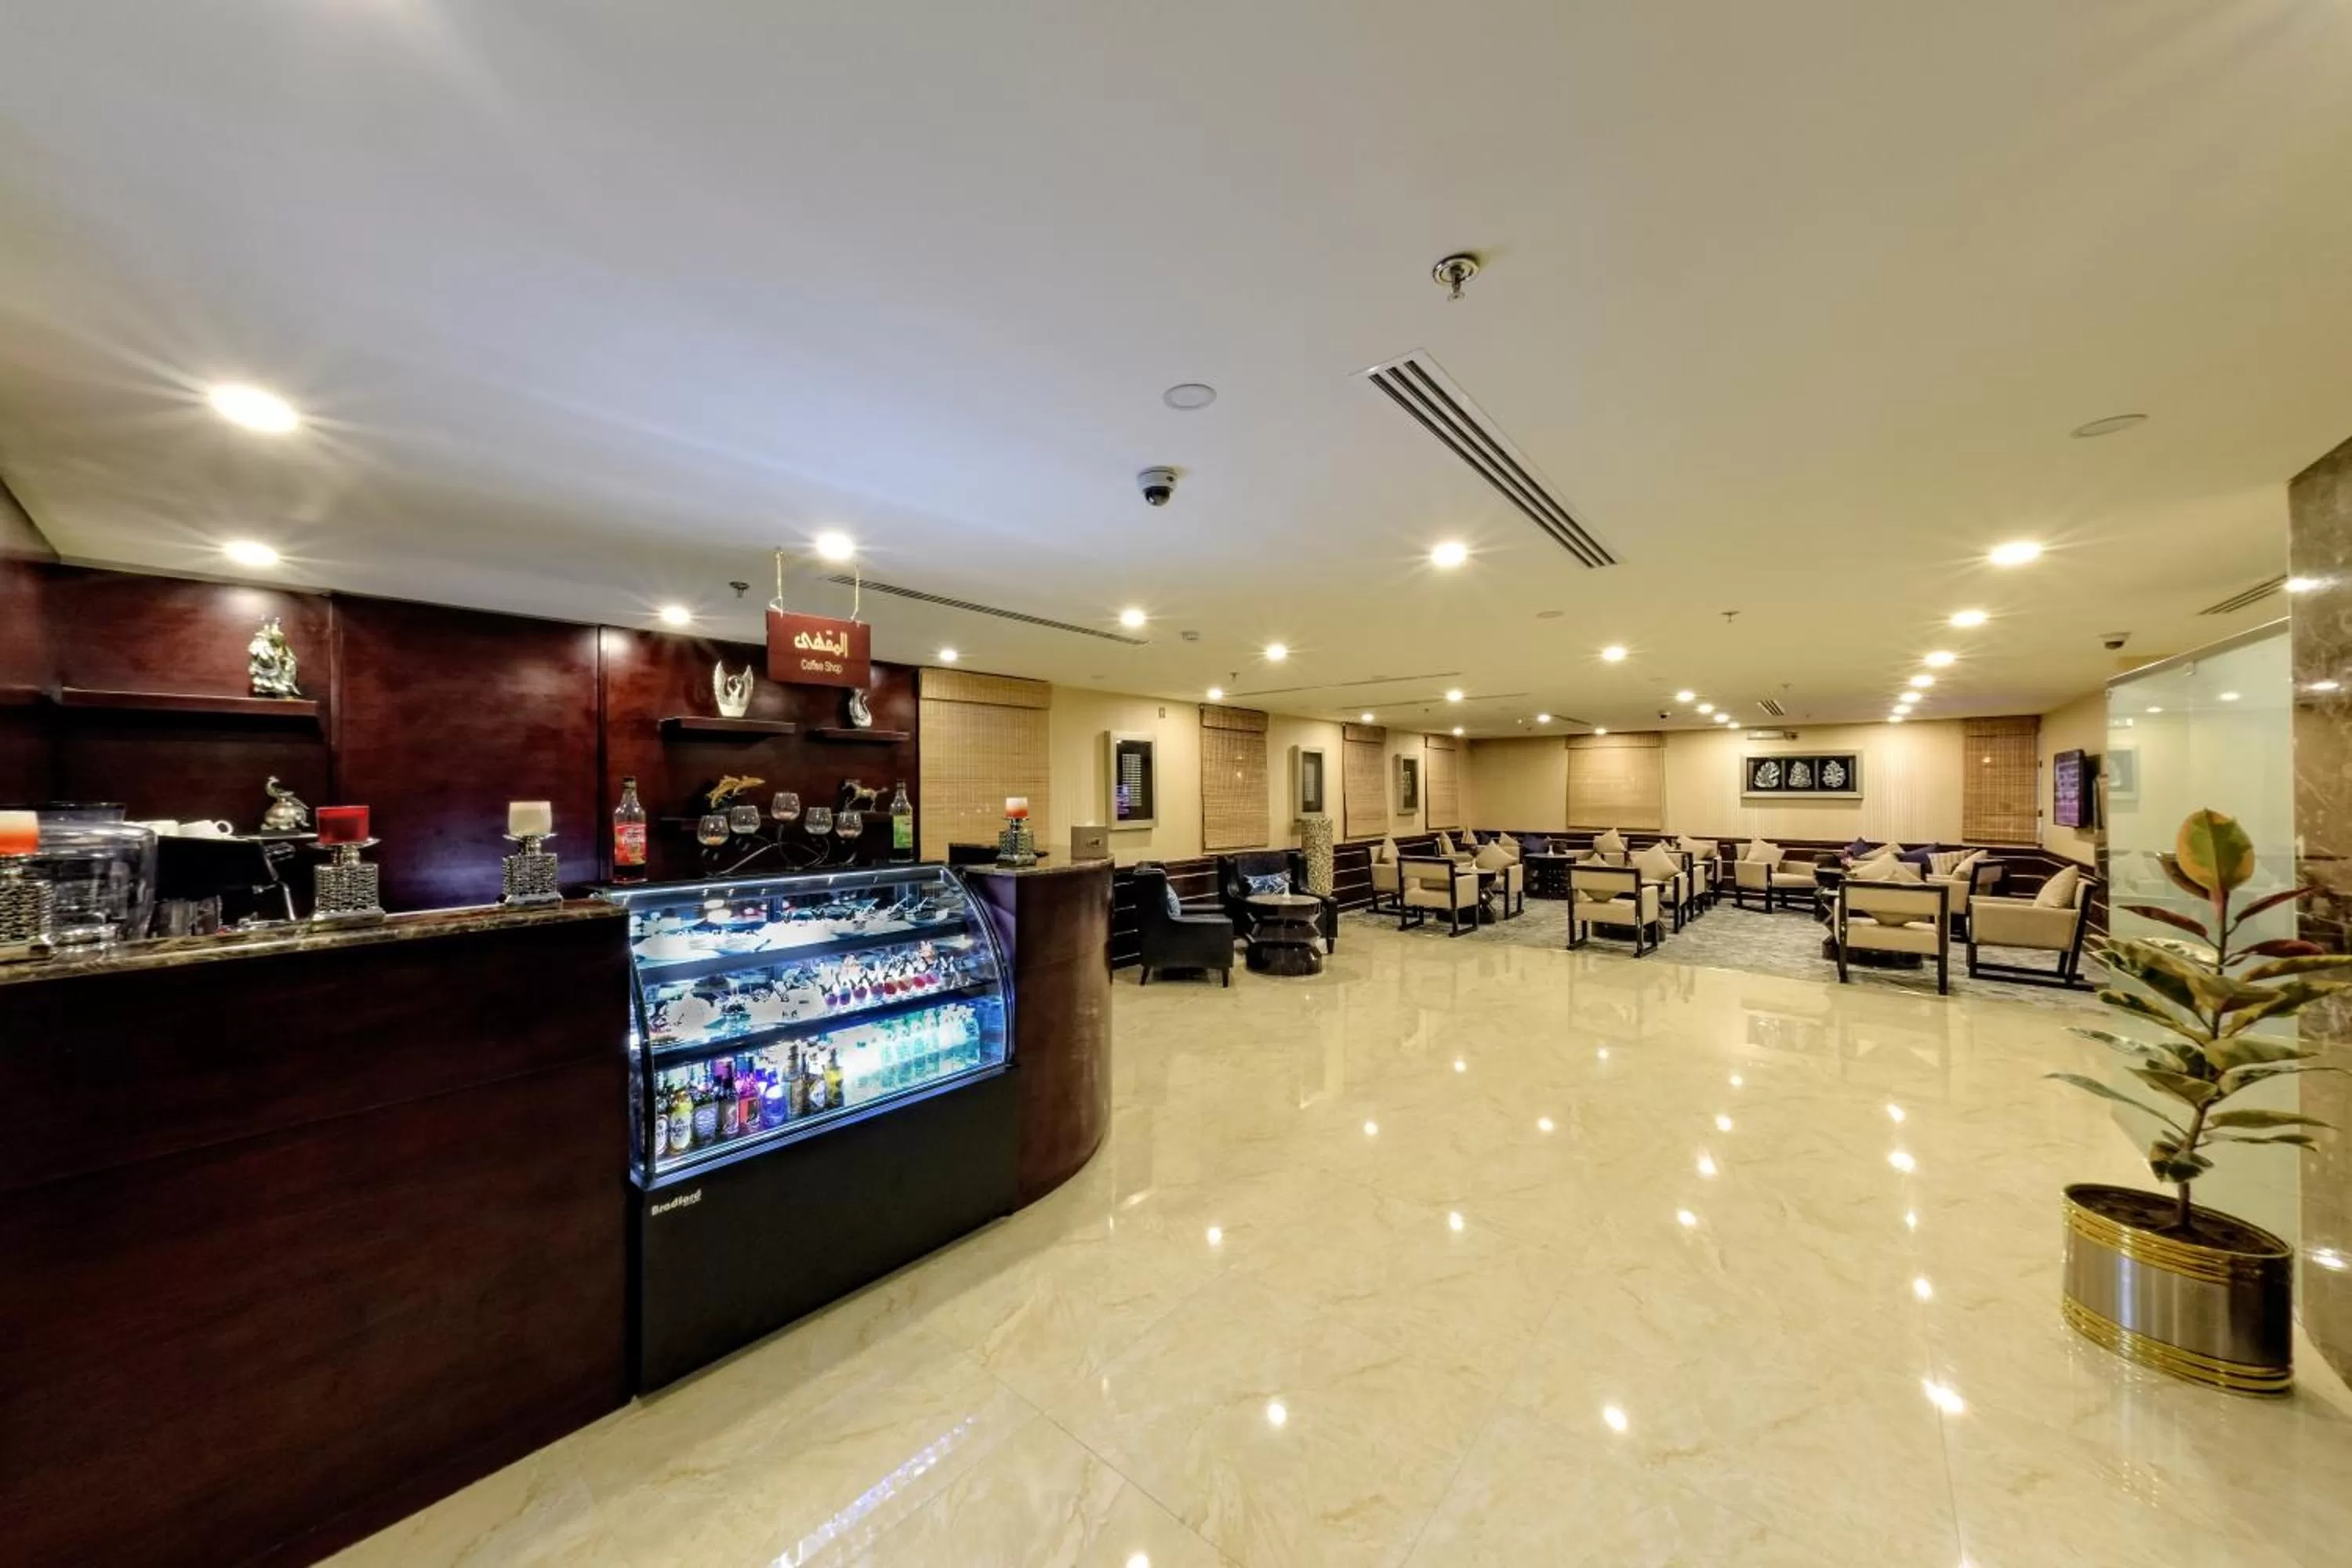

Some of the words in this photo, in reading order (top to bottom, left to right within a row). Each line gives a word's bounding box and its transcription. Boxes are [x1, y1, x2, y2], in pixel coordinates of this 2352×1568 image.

[794, 630, 848, 657] المقهى
[800, 659, 823, 670] Coffee
[824, 661, 842, 674] Shop
